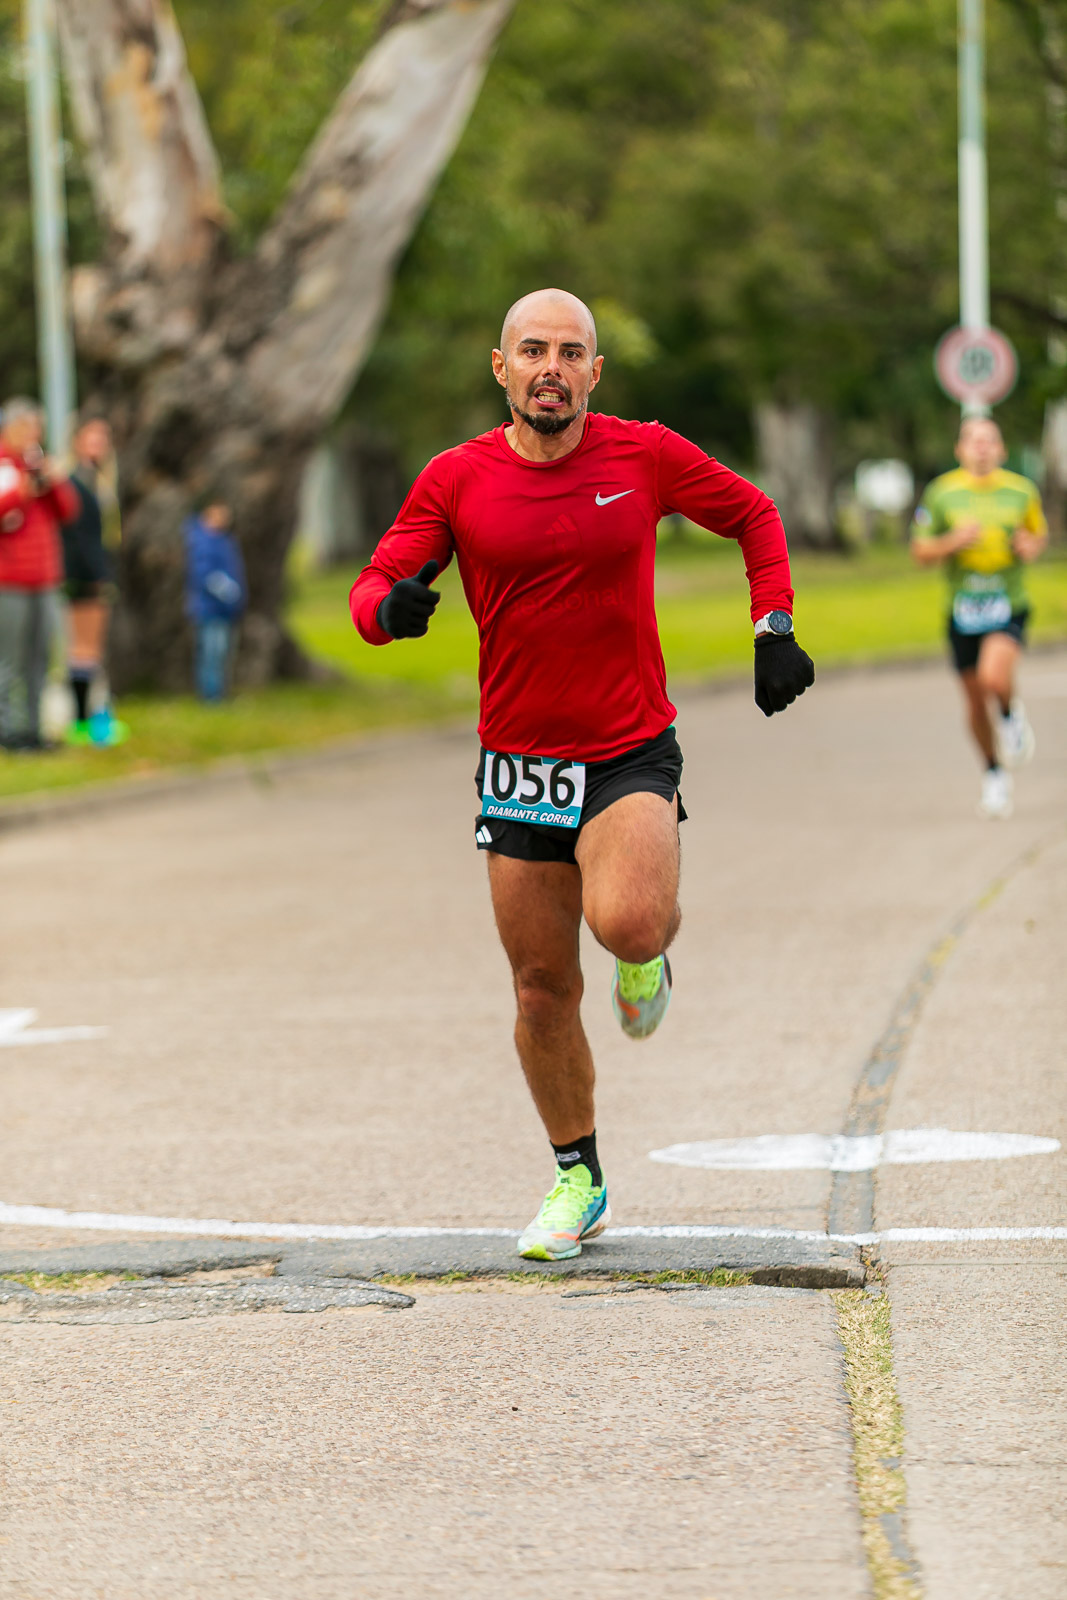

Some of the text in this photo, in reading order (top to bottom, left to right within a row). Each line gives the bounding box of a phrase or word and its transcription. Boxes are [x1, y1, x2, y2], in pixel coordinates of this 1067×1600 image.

[491, 752, 575, 810] 056
[487, 805, 575, 826] DIAMANTE CORRE
